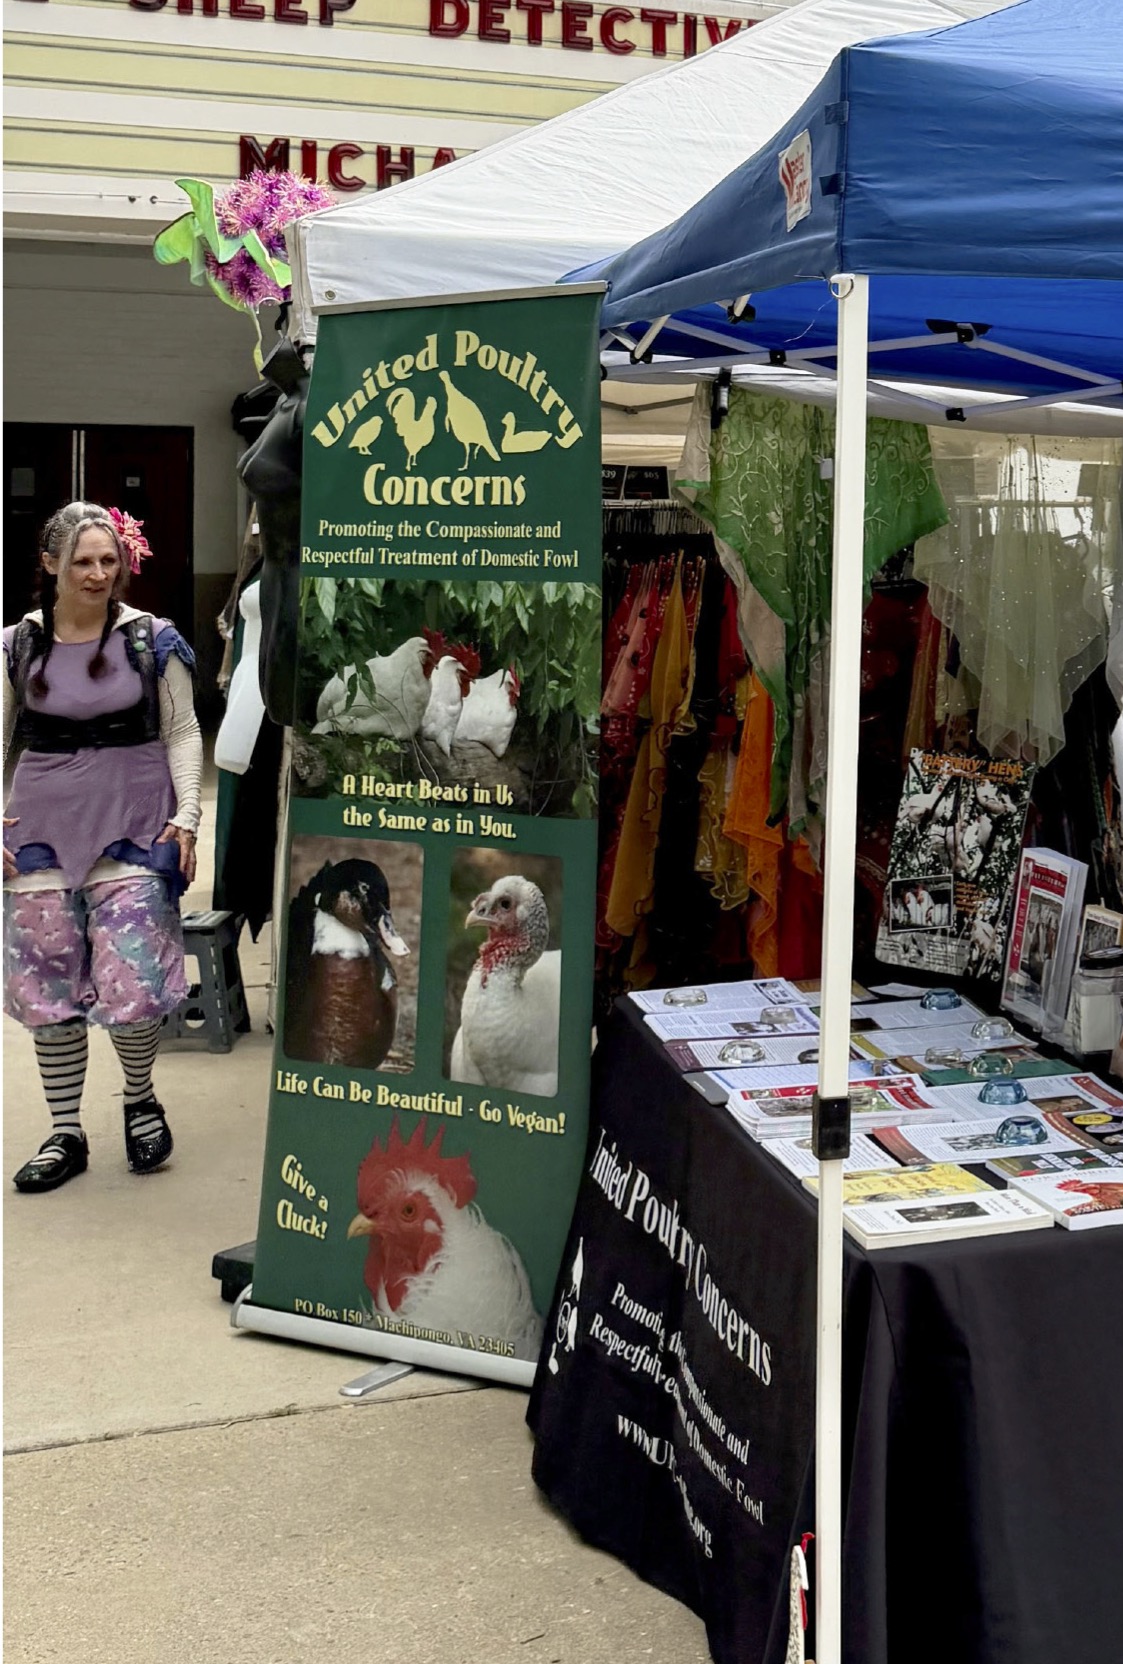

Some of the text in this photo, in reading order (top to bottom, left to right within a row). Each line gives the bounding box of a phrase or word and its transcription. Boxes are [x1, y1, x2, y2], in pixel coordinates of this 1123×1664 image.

[429, 0, 767, 59] DETECTIV
[311, 330, 583, 448] United Poultry
[363, 463, 526, 506] Concerns
[319, 520, 561, 542] Promoting the Compassionate and
[302, 547, 578, 568] Respectful Treatment of Domestic Fowl
[343, 775, 513, 806] A Heart Beats in Us
[343, 806, 517, 840] the Same as in You.
[276, 1070, 308, 1095] Life
[312, 1076, 345, 1100] Can
[349, 1081, 372, 1103] Be
[376, 1085, 463, 1117] Beautiful
[479, 1099, 501, 1123] Go
[507, 1104, 566, 1134] Vegan!
[281, 1154, 329, 1212] Give a
[276, 1199, 328, 1239] Cluck!
[295, 1299, 515, 1356] PO Box 150 Machipongo, VA 23405
[695, 1243, 772, 1386] Concerns
[727, 1431, 750, 1465] and
[736, 1478, 764, 1525] Fowl
